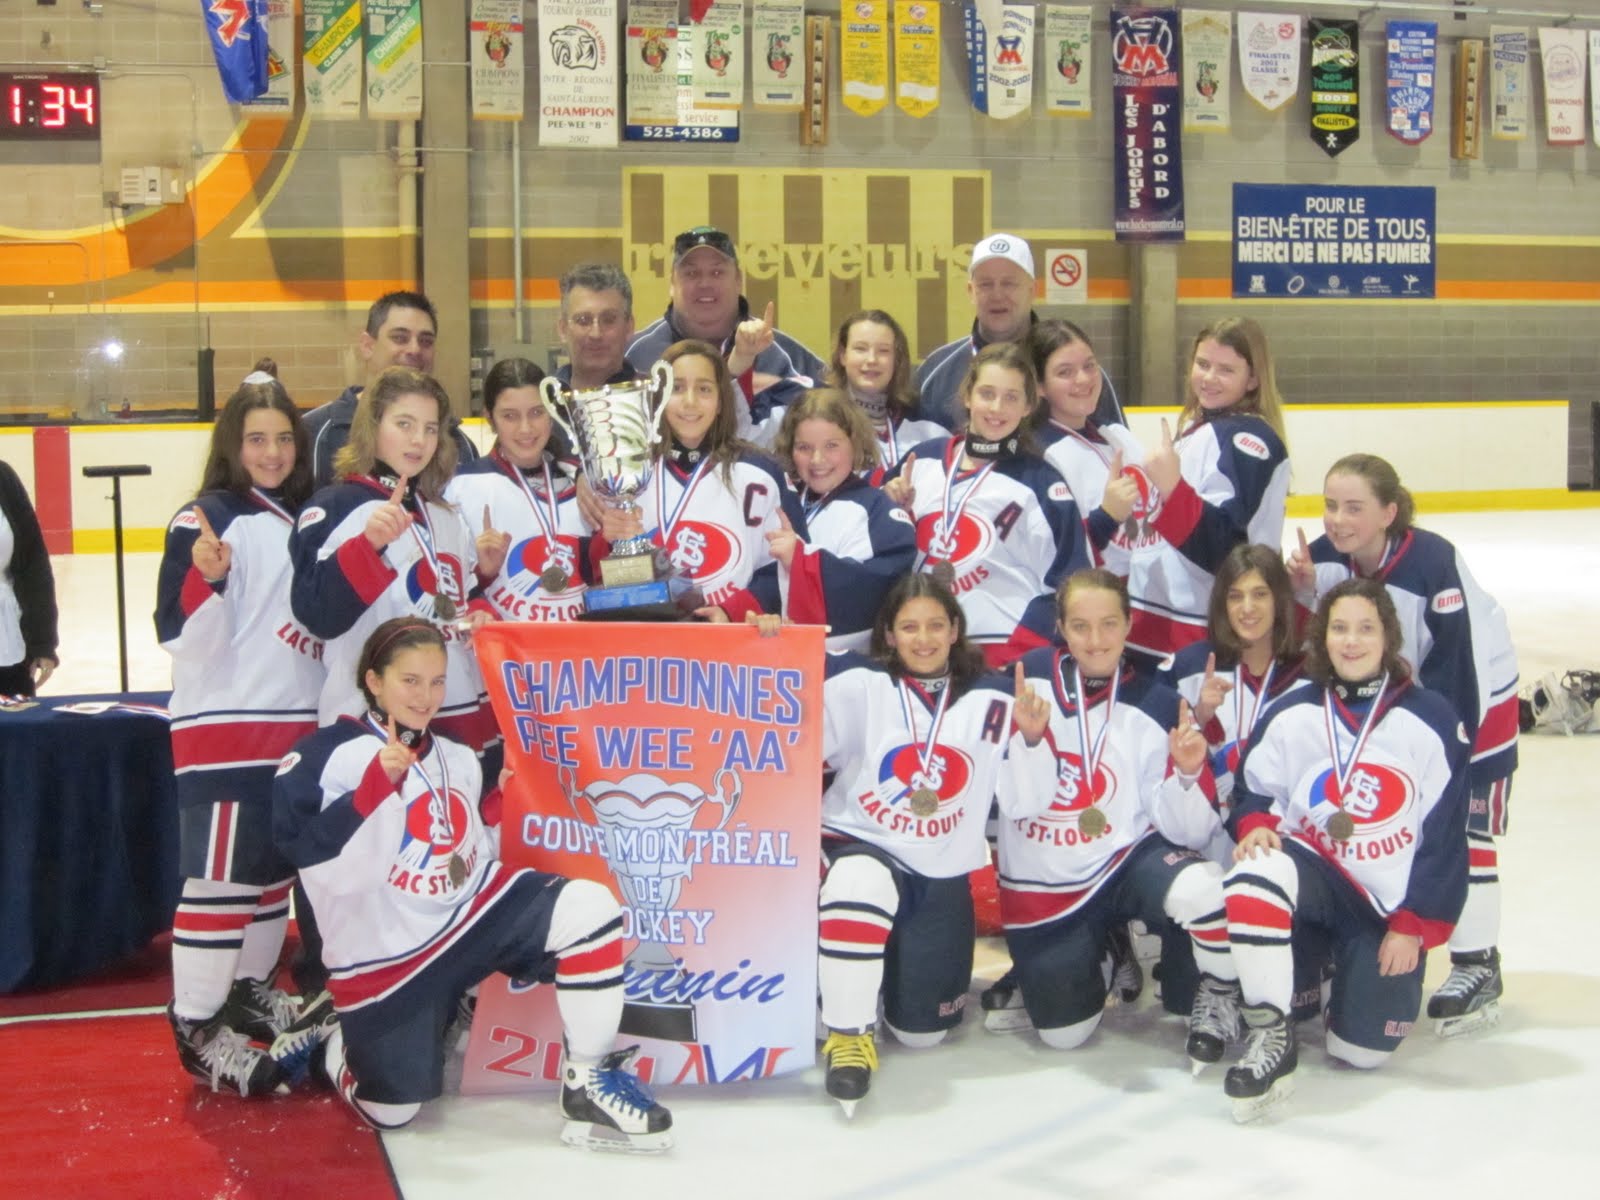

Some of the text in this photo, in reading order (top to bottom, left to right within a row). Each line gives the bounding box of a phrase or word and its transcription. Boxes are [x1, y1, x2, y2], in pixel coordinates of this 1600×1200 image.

[11, 85, 94, 127] 1:34
[542, 106, 615, 118] CHAMPION
[685, 113, 719, 124] service
[547, 121, 586, 129] PEE-WEE
[568, 135, 590, 144] 2002
[642, 126, 723, 139] 525-4386
[1306, 197, 1365, 213] POUR LE
[1238, 213, 1431, 243] BIEN-ÊTRE DE TOUS,
[1238, 241, 1431, 264] MERCI DE NE PAS FUMER
[743, 482, 768, 527] C
[994, 500, 1024, 542] A
[492, 587, 521, 617] LAC
[276, 621, 307, 653] LAC
[501, 656, 804, 727] CHAMPIONNES
[981, 699, 1008, 744] A
[514, 714, 580, 769] PEE
[594, 726, 694, 771] WEE
[858, 790, 891, 826] LAC
[521, 812, 800, 867] COUPE MONTRÉAL
[387, 863, 424, 895] LAC
[633, 876, 663, 905] DE
[622, 906, 715, 946] OCKEY
